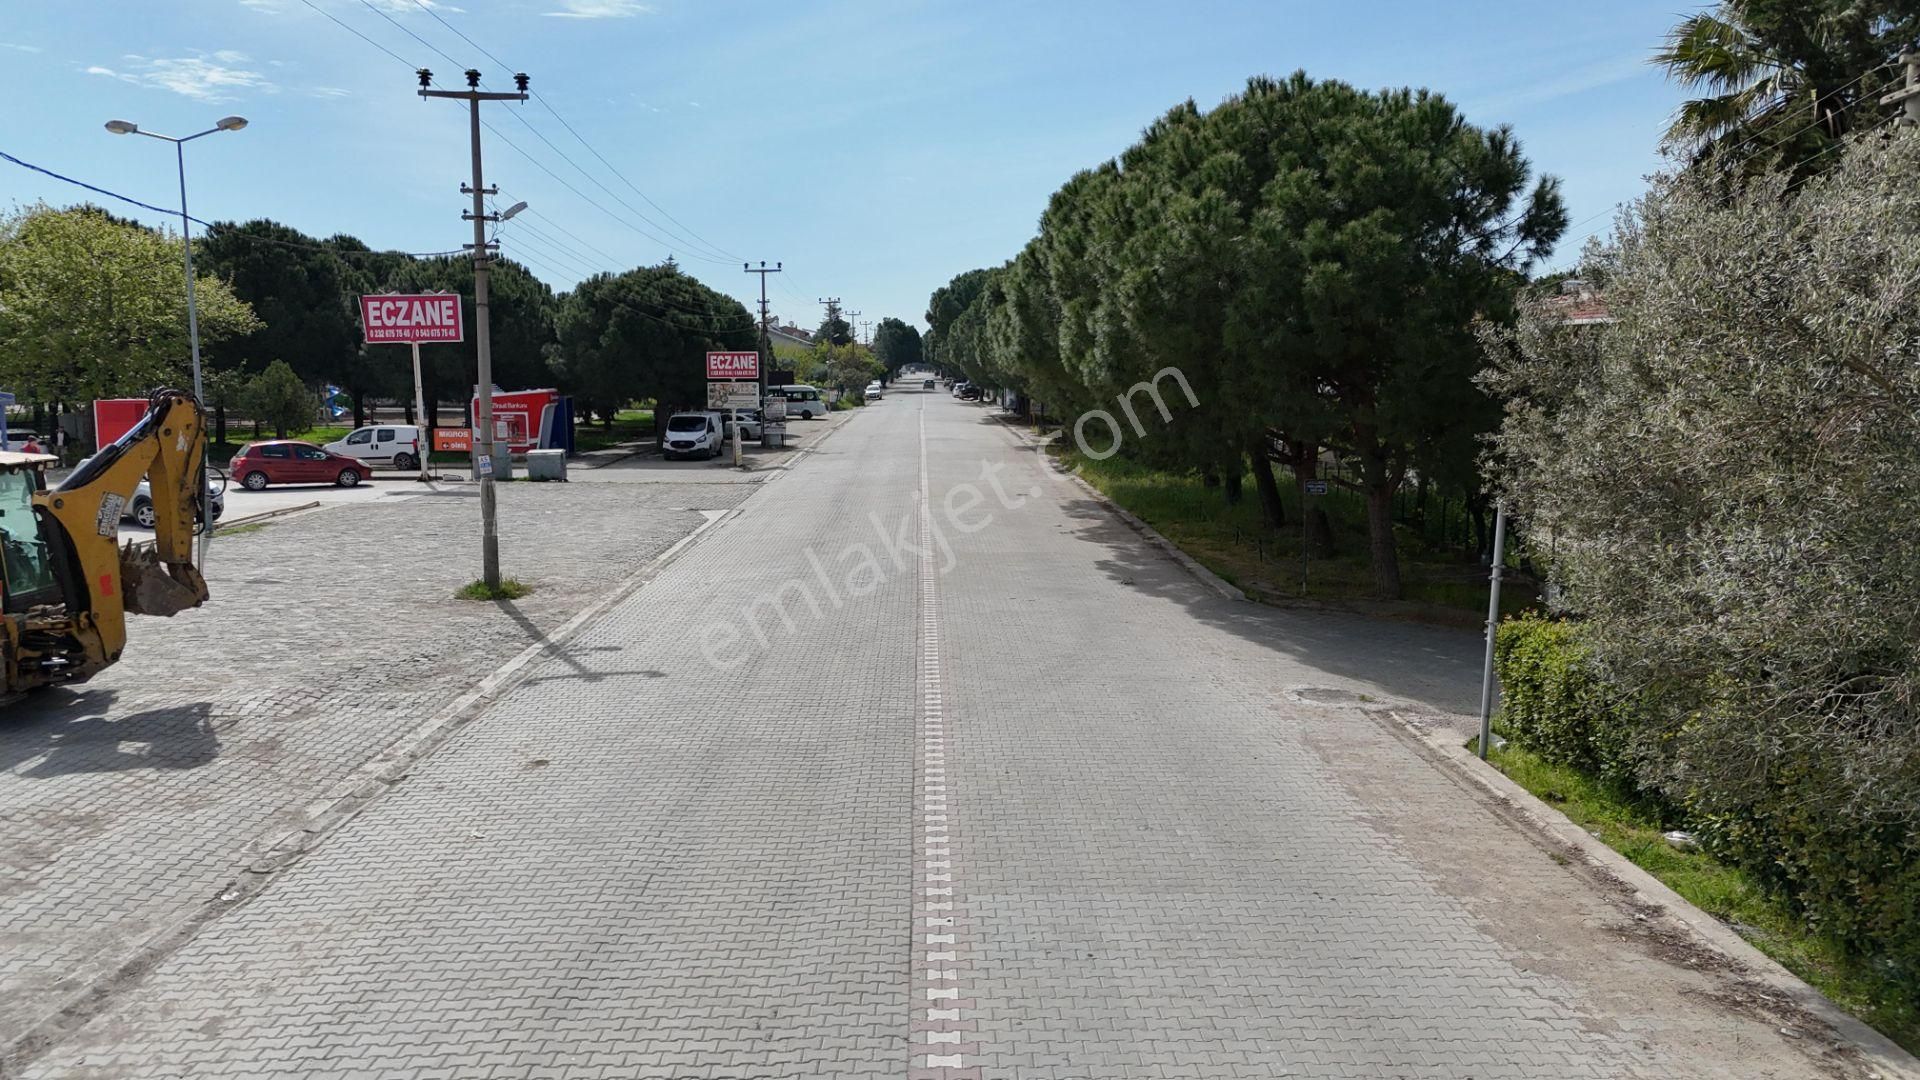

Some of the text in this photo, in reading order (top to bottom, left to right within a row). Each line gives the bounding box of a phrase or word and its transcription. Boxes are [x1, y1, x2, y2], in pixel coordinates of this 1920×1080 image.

[367, 300, 455, 326] ECZANE
[374, 329, 385, 338] 232
[710, 355, 756, 369] ECZANE
